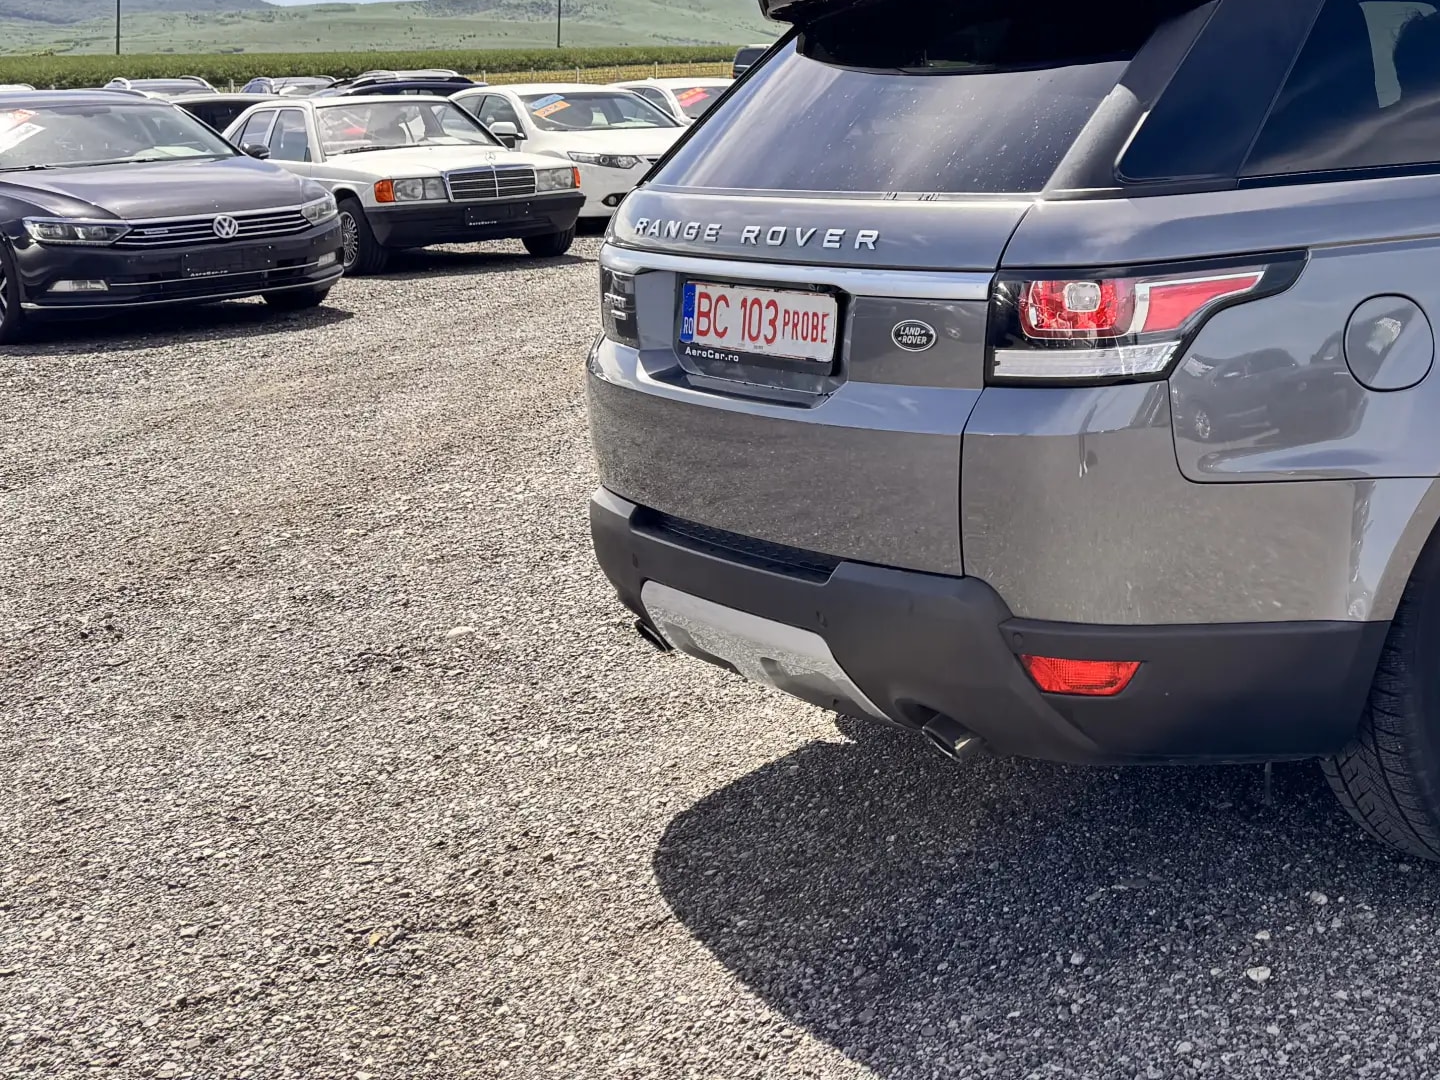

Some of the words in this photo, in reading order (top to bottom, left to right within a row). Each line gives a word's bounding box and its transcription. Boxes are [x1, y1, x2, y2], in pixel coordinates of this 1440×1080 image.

[634, 217, 722, 242] RANGE
[740, 225, 880, 251] ROVER
[683, 316, 694, 335] RO
[696, 291, 730, 339] BC
[740, 297, 779, 345] 103
[782, 308, 830, 344] PROBE
[900, 326, 921, 336] LAND
[685, 346, 740, 363] AeroCar.ro
